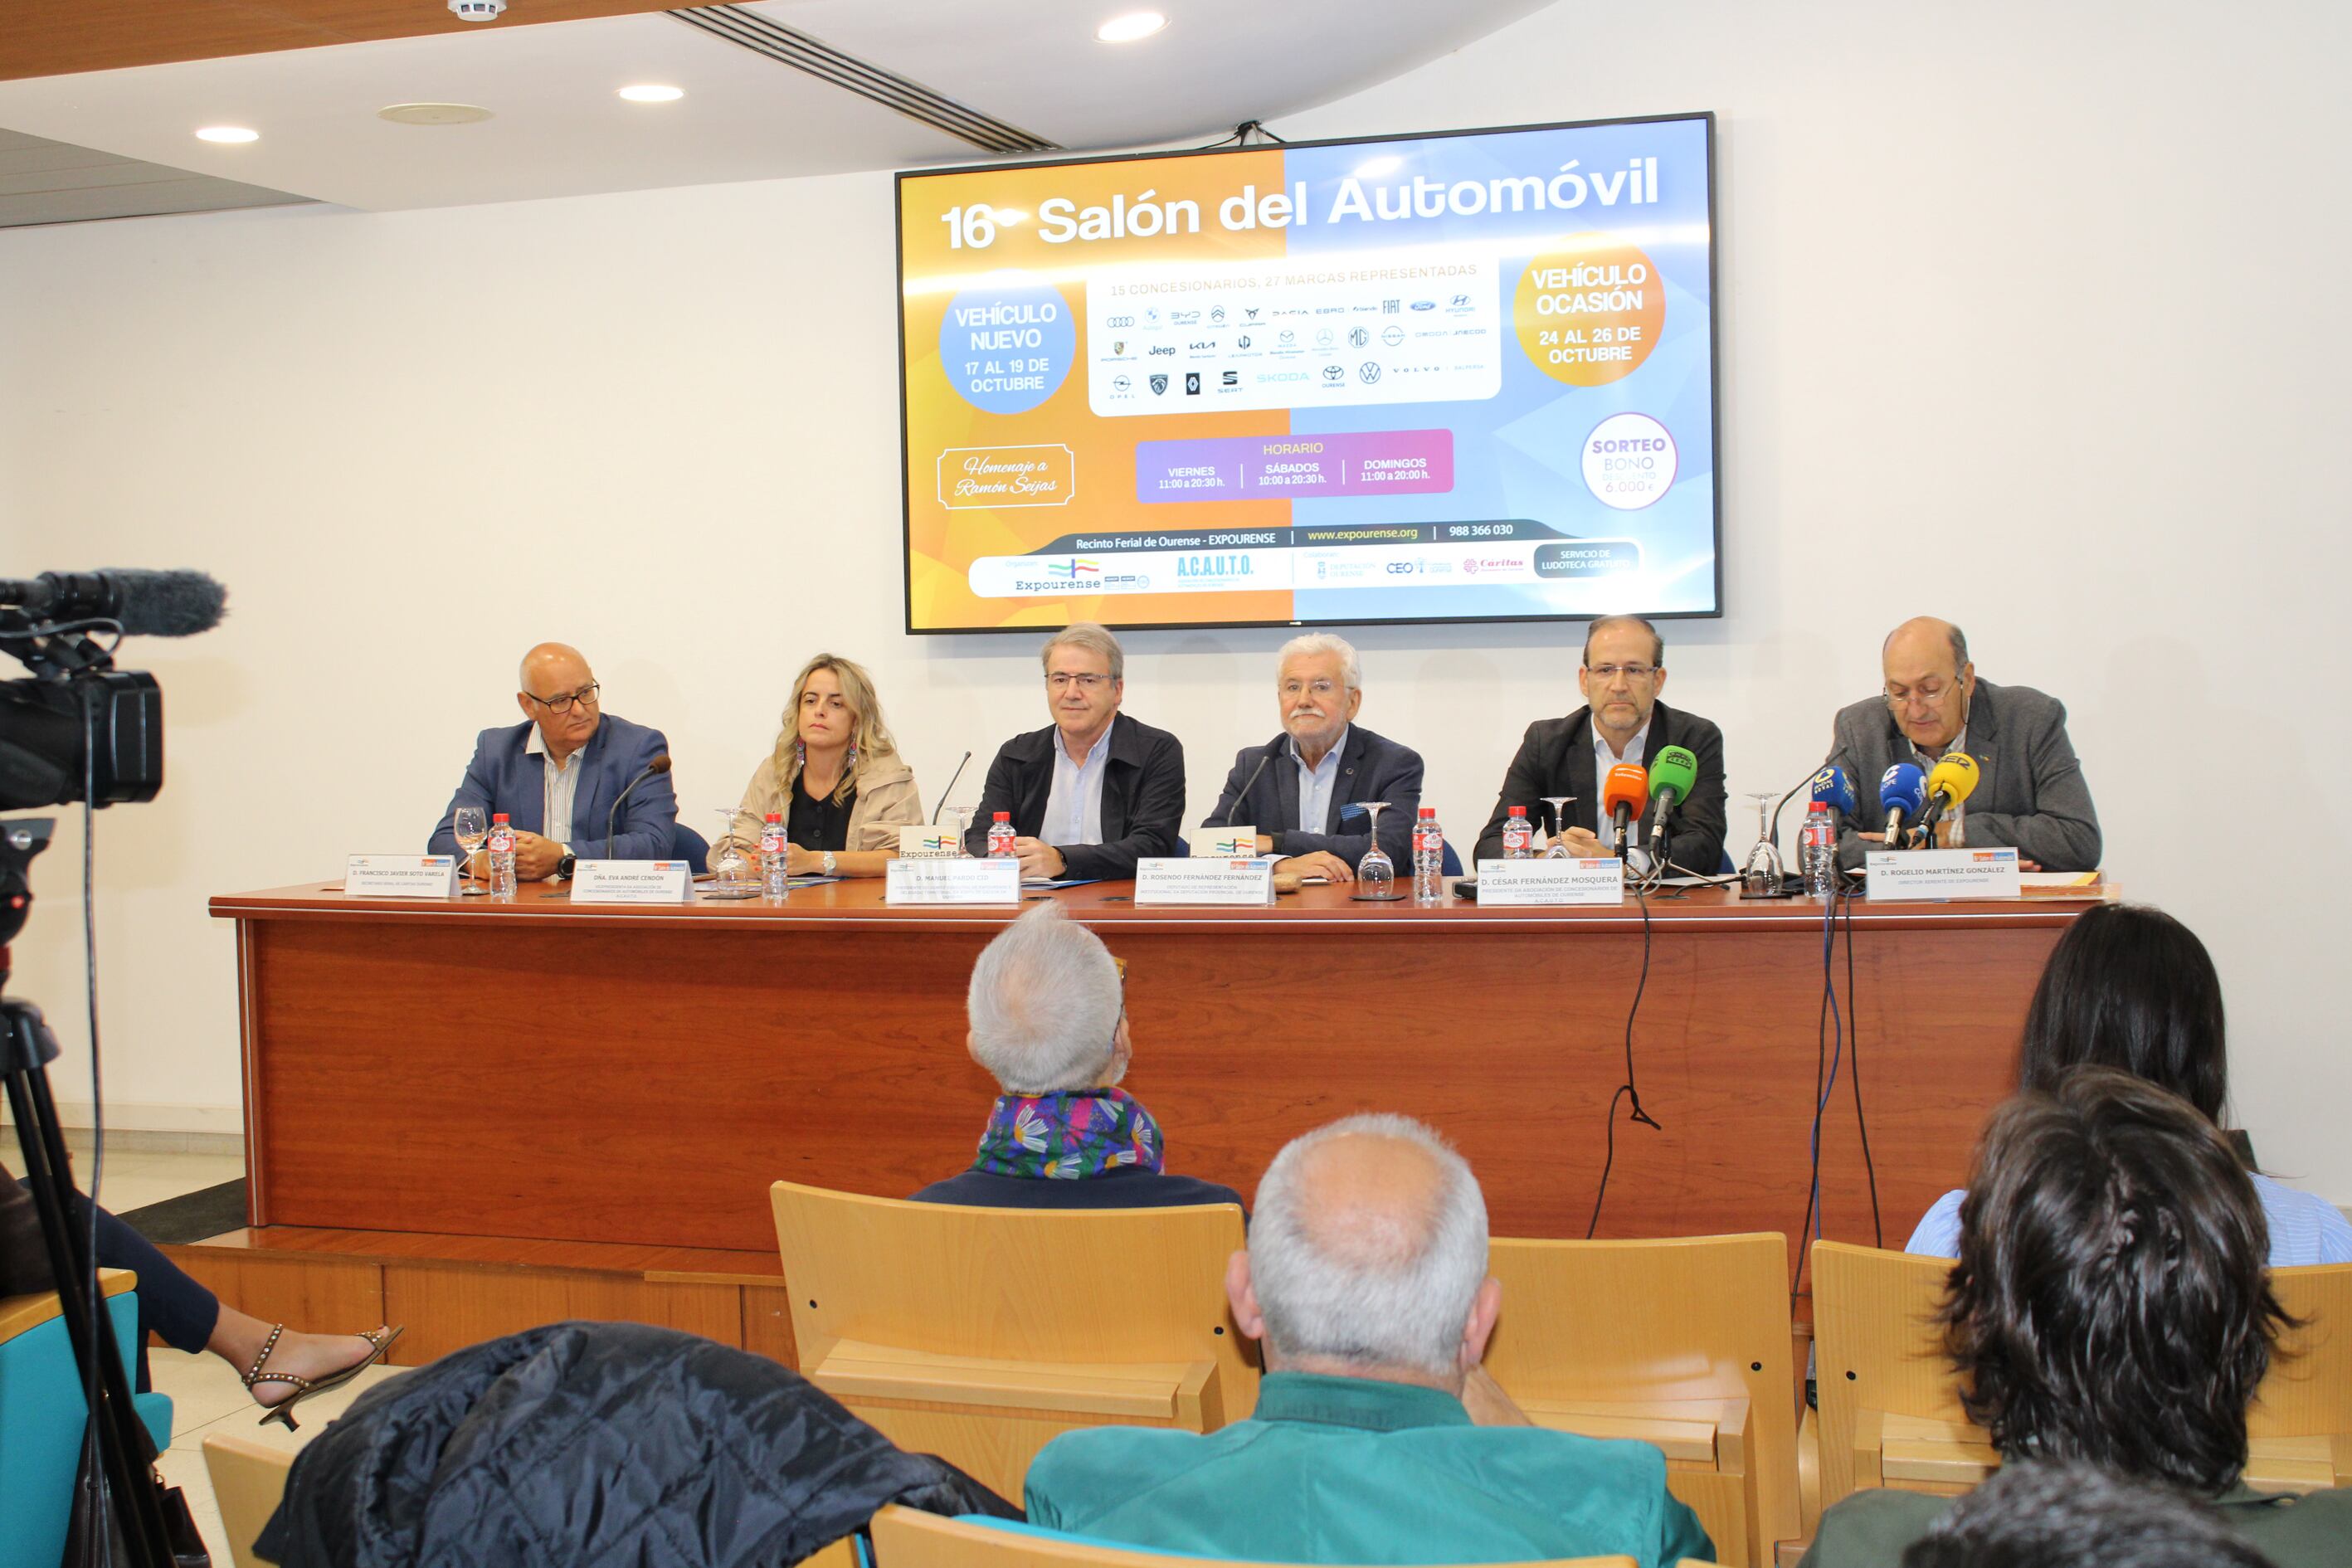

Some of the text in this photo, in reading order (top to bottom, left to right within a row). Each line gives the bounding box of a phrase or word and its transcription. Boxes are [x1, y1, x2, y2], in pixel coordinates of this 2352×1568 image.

[1039, 189, 1200, 243] Salón
[1219, 181, 1307, 231] del
[1327, 157, 1658, 224] Automóvil
[1111, 264, 1478, 296] 15 CONCESIONARIOS, 27 MARCAS REPRESENTADAS
[1531, 261, 1647, 290] VEHÍCULO
[1383, 299, 1400, 314] FIAT
[1536, 285, 1643, 315] OCASIÓN
[955, 301, 1057, 327] VEHÍCULO
[971, 329, 1042, 350] NUEVO
[1351, 329, 1367, 346] MG
[1539, 326, 1641, 345] 24 AL 26 DE
[1148, 345, 1176, 356] Jeep
[1549, 346, 1632, 364] OCTUBRE
[965, 358, 1049, 375] 17 AL 19 DE
[971, 376, 1045, 392] OCTUBRE
[1264, 442, 1323, 455] HORARIO
[1592, 438, 1666, 454] SORTEO
[963, 456, 1048, 476] Homenaje a
[1265, 462, 1320, 474] SÁBADOS
[1364, 458, 1427, 470] DOMINGOS
[1605, 456, 1654, 470] BONO
[1168, 466, 1215, 477] VIERNES
[1361, 471, 1386, 481] 11:00
[1395, 470, 1420, 480] 20:00
[1421, 470, 1430, 479] h.
[954, 476, 1057, 496] Ramón Seijas
[1159, 479, 1183, 489] 11:00
[1191, 478, 1216, 488] 20:30
[1217, 477, 1225, 487] h.
[1259, 475, 1283, 485] 10:00
[1291, 475, 1317, 485] 20:30
[1317, 474, 1327, 484] h.
[1605, 480, 1645, 493] 6.000
[1308, 528, 1418, 541] www.expourense.org
[1449, 524, 1513, 536] 988 366 030
[1077, 539, 1113, 549] Recinto
[1115, 538, 1142, 548] Ferial
[1144, 537, 1157, 547] de
[1159, 536, 1200, 547] Ourense
[1209, 533, 1276, 545] EXPOURENSE
[1561, 549, 1611, 559] SERVICIO DE
[1177, 555, 1254, 577] A.C.A.U.T.O.
[1386, 562, 1414, 574] CEO
[1542, 561, 1586, 570] LUDOTECA
[1015, 580, 1101, 592] Expourense
[900, 850, 957, 859] Expourense
[1926, 867, 1965, 875] MARTÍNEZ
[1492, 877, 1518, 885] CÉSAR
[1521, 876, 1570, 885] FERNÁNDEZ
[1571, 876, 1618, 884] MOSQUERA
